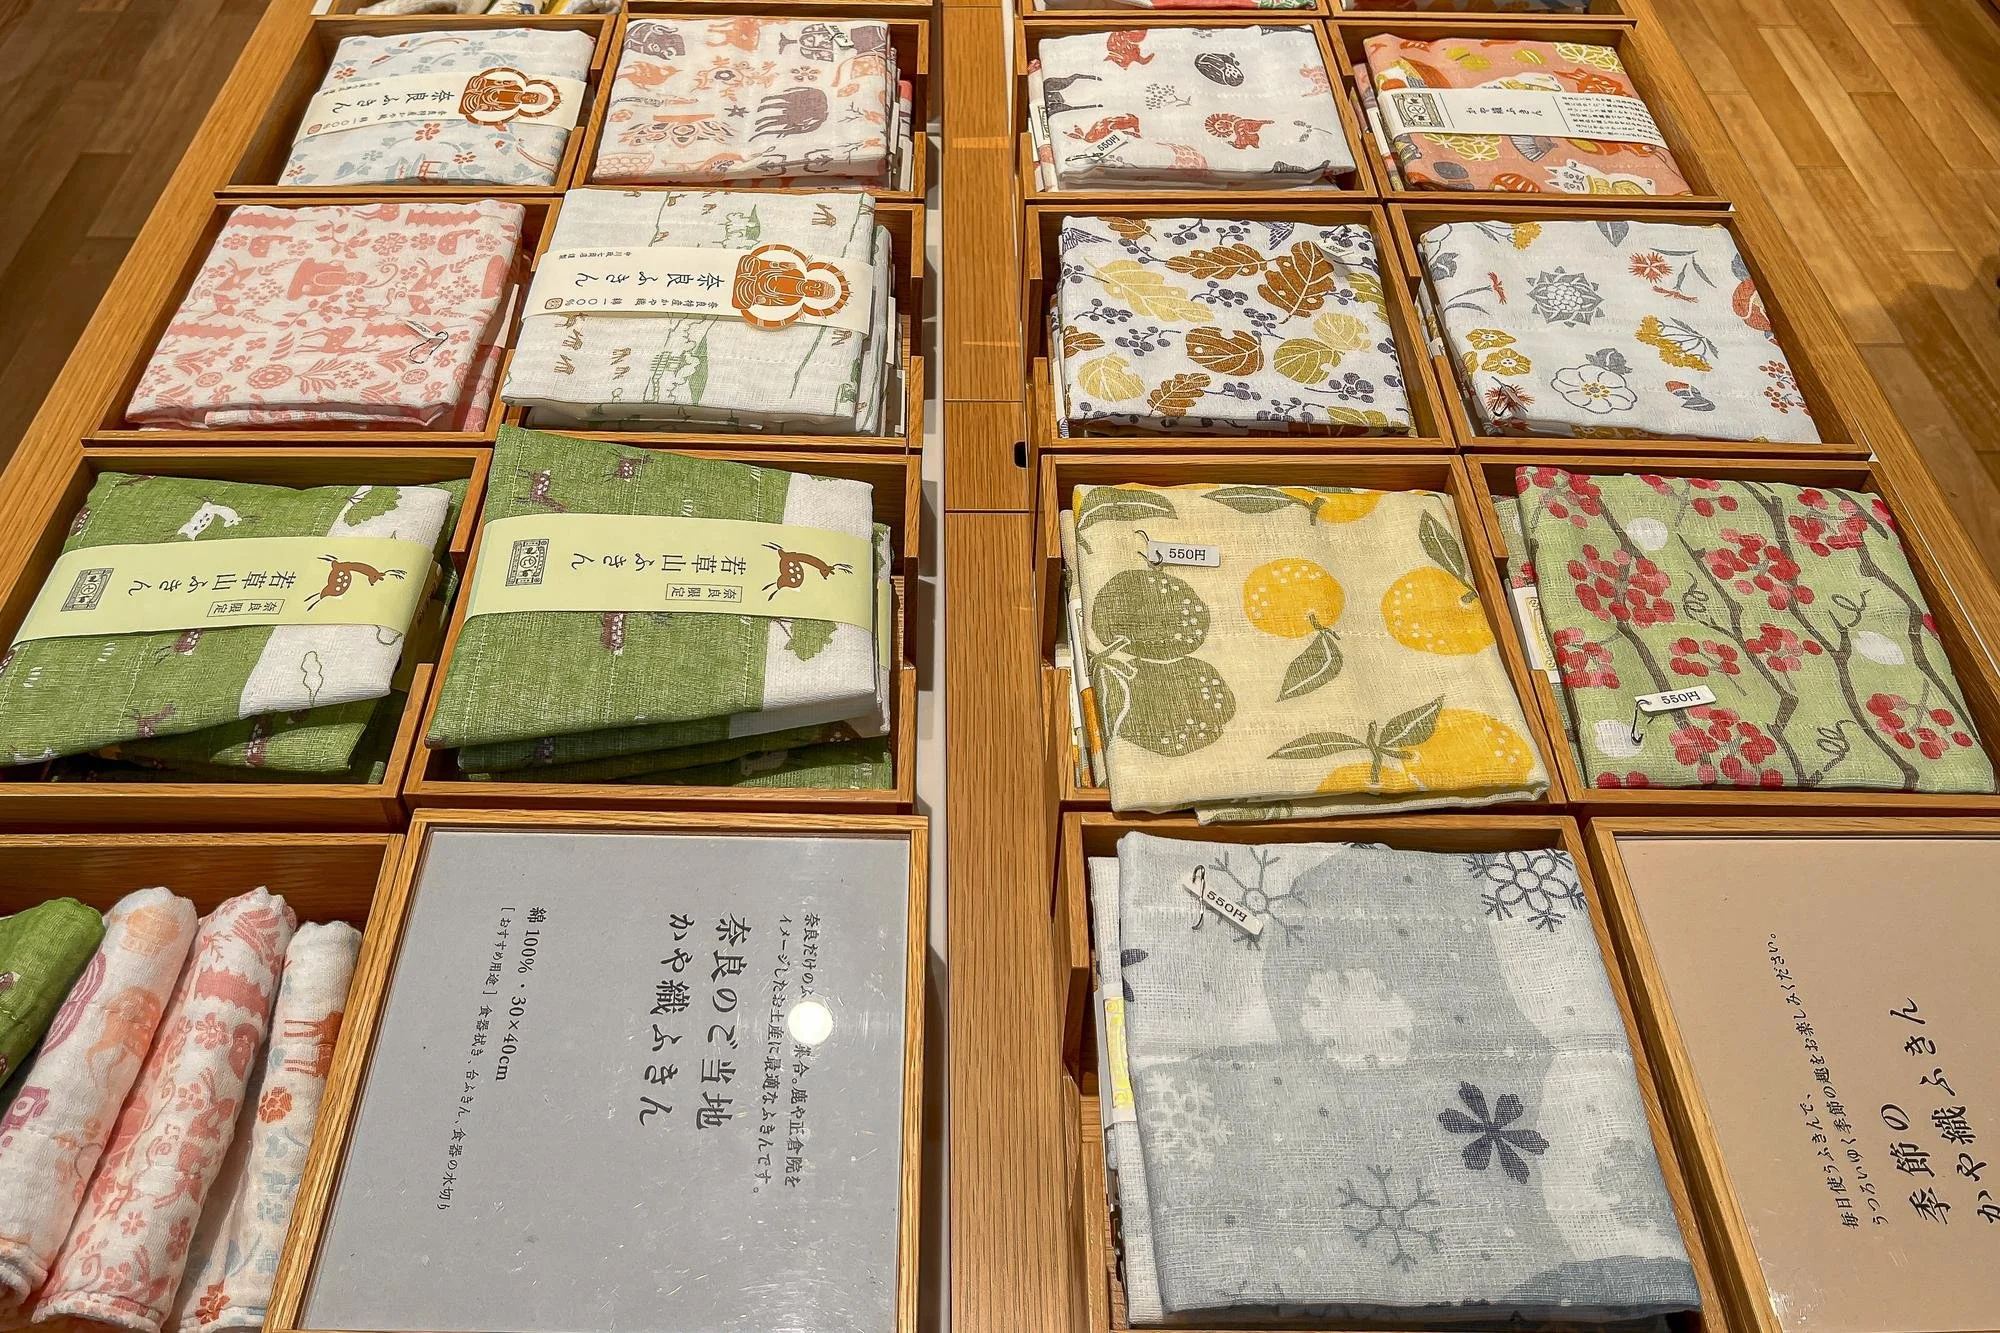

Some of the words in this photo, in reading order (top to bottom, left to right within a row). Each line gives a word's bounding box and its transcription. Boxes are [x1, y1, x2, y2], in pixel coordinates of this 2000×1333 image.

[331, 91, 455, 113] 奈良ふきん
[573, 271, 725, 290] 奈良ふきん
[127, 569, 298, 597] 若草山ふきん
[570, 552, 747, 576] 若草山ふきん
[1169, 548, 1206, 561] 550円
[1660, 690, 1701, 705] 550円
[1206, 890, 1248, 923] 550円
[639, 912, 695, 1127] かや織ふきん
[695, 912, 752, 1130] 奈良のご当地
[752, 914, 794, 1194] イメージしたお土産に最適なふきんです。
[784, 911, 821, 1188] 奈良だけのふ集合。鹿や正倉院を
[1767, 933, 1889, 1226] うつろいゆく季節の趣をお楽しみください。
[1799, 1094, 1860, 1229] 毎日使うふきんで、
[1880, 1103, 1952, 1225] 季節の
[1889, 997, 2000, 1225] かや織ふきん
